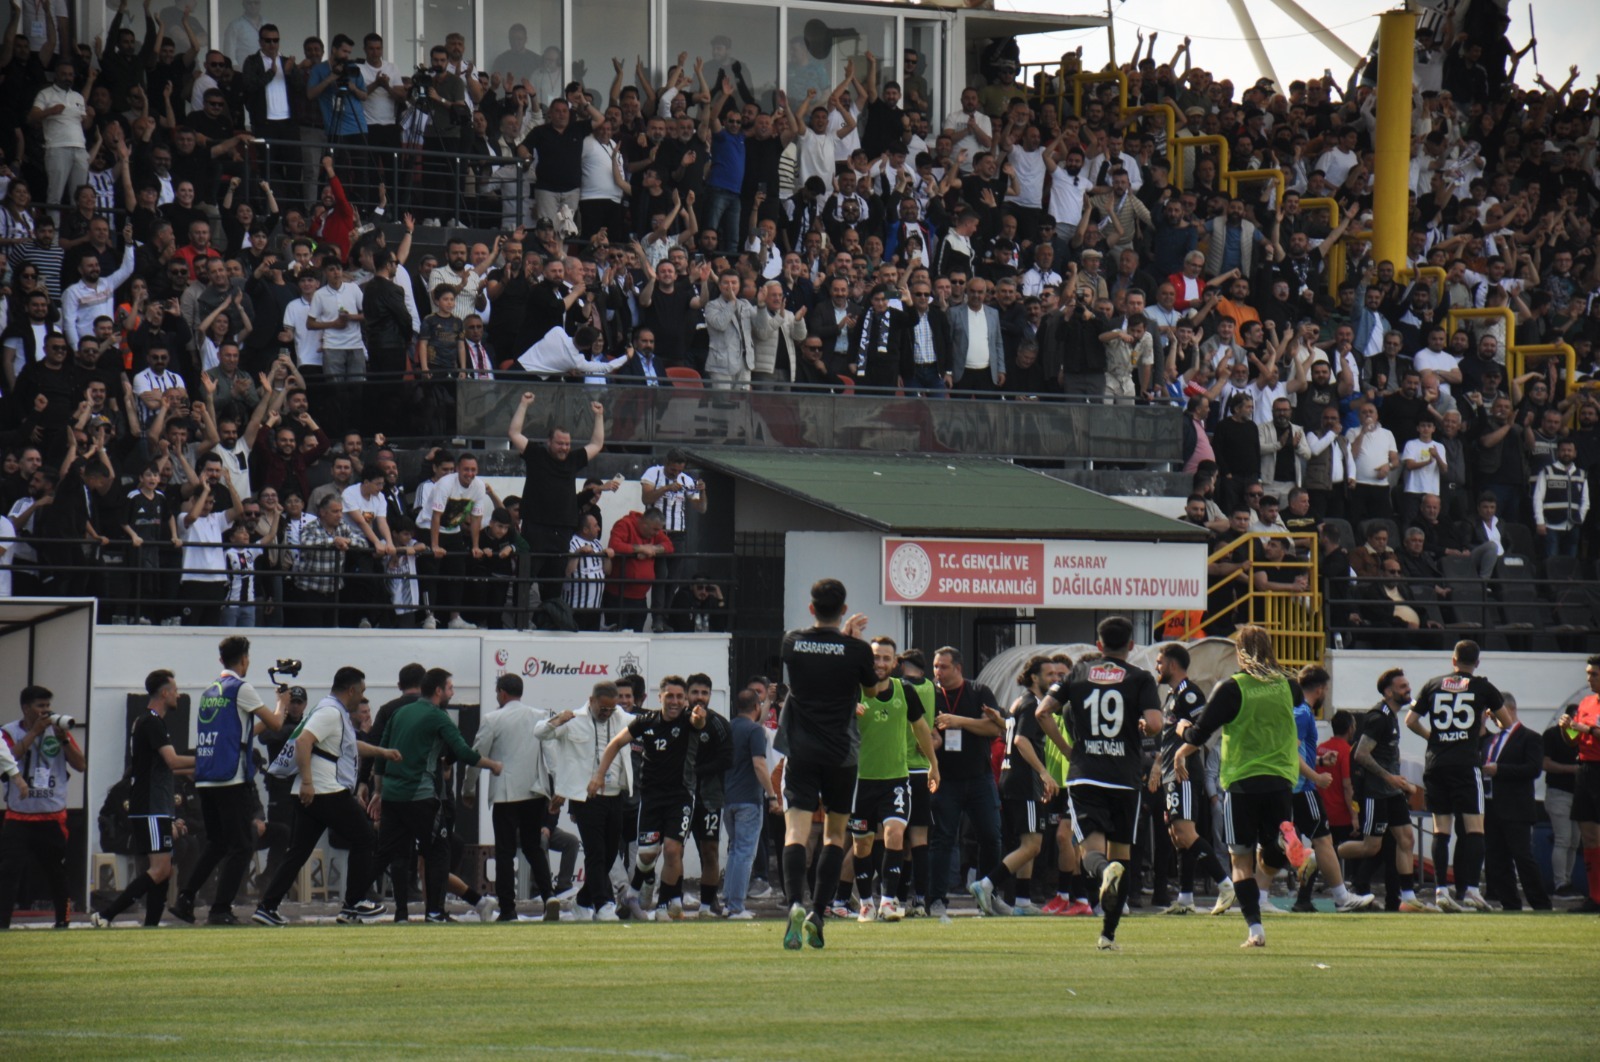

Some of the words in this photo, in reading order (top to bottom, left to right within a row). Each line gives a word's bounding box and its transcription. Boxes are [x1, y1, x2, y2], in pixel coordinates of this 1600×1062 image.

[938, 554, 960, 569] T.C.
[961, 552, 1012, 574] GENÇLİK
[1014, 556, 1029, 570] VE
[1053, 556, 1108, 569] AKSARAY
[938, 578, 970, 593] SPOR
[972, 577, 1037, 595] BAKANLIĞI
[1052, 573, 1122, 596] DAĞILGAN
[1125, 578, 1200, 597] STADYUMU
[793, 640, 845, 656] AKSARAYSPOR
[1083, 688, 1125, 738] 19
[1433, 692, 1475, 730] 55
[654, 738, 668, 751] 12
[681, 815, 690, 831] 8
[704, 813, 719, 830] 12
